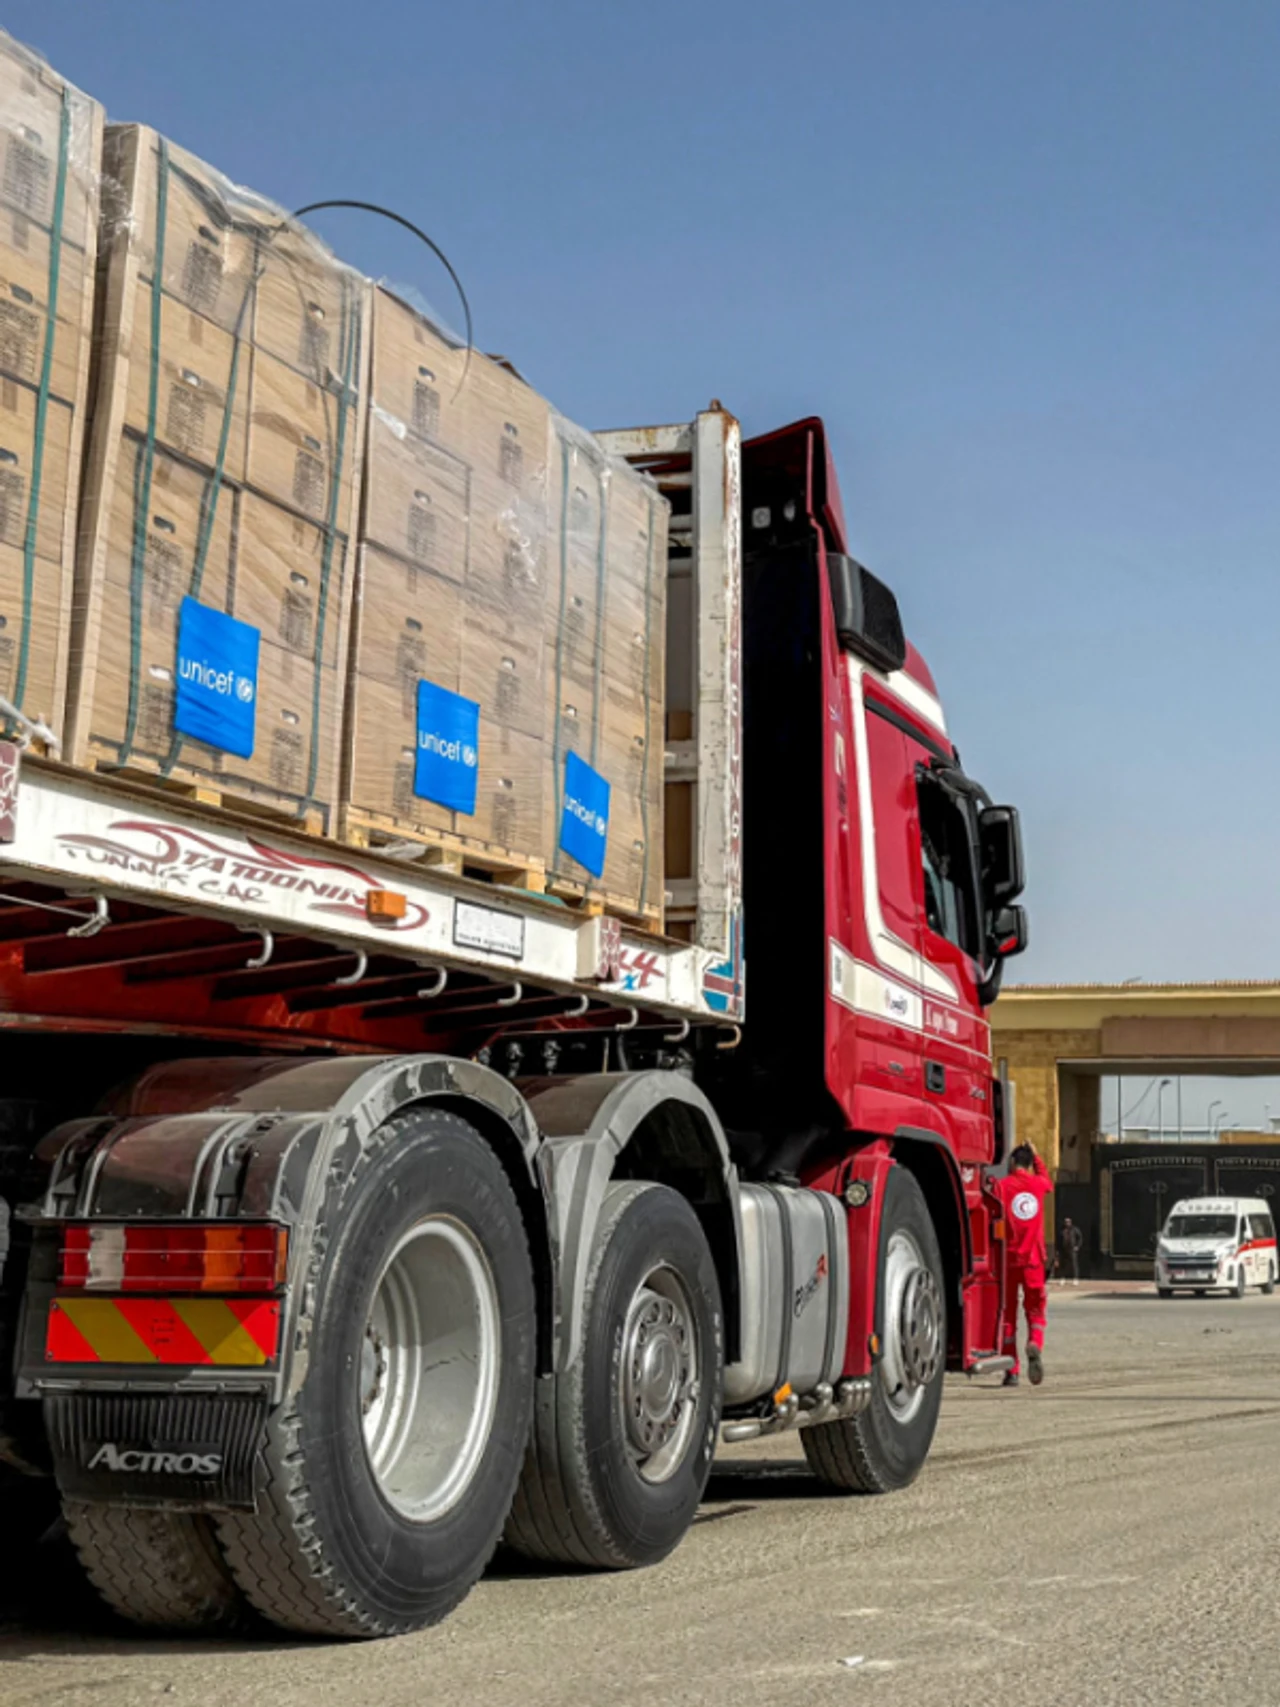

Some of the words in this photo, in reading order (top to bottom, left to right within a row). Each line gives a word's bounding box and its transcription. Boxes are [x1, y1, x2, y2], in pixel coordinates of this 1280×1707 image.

[179, 657, 234, 696] unicef
[418, 730, 461, 762] unicef
[564, 794, 596, 828] unicef
[198, 880, 270, 904] CAR
